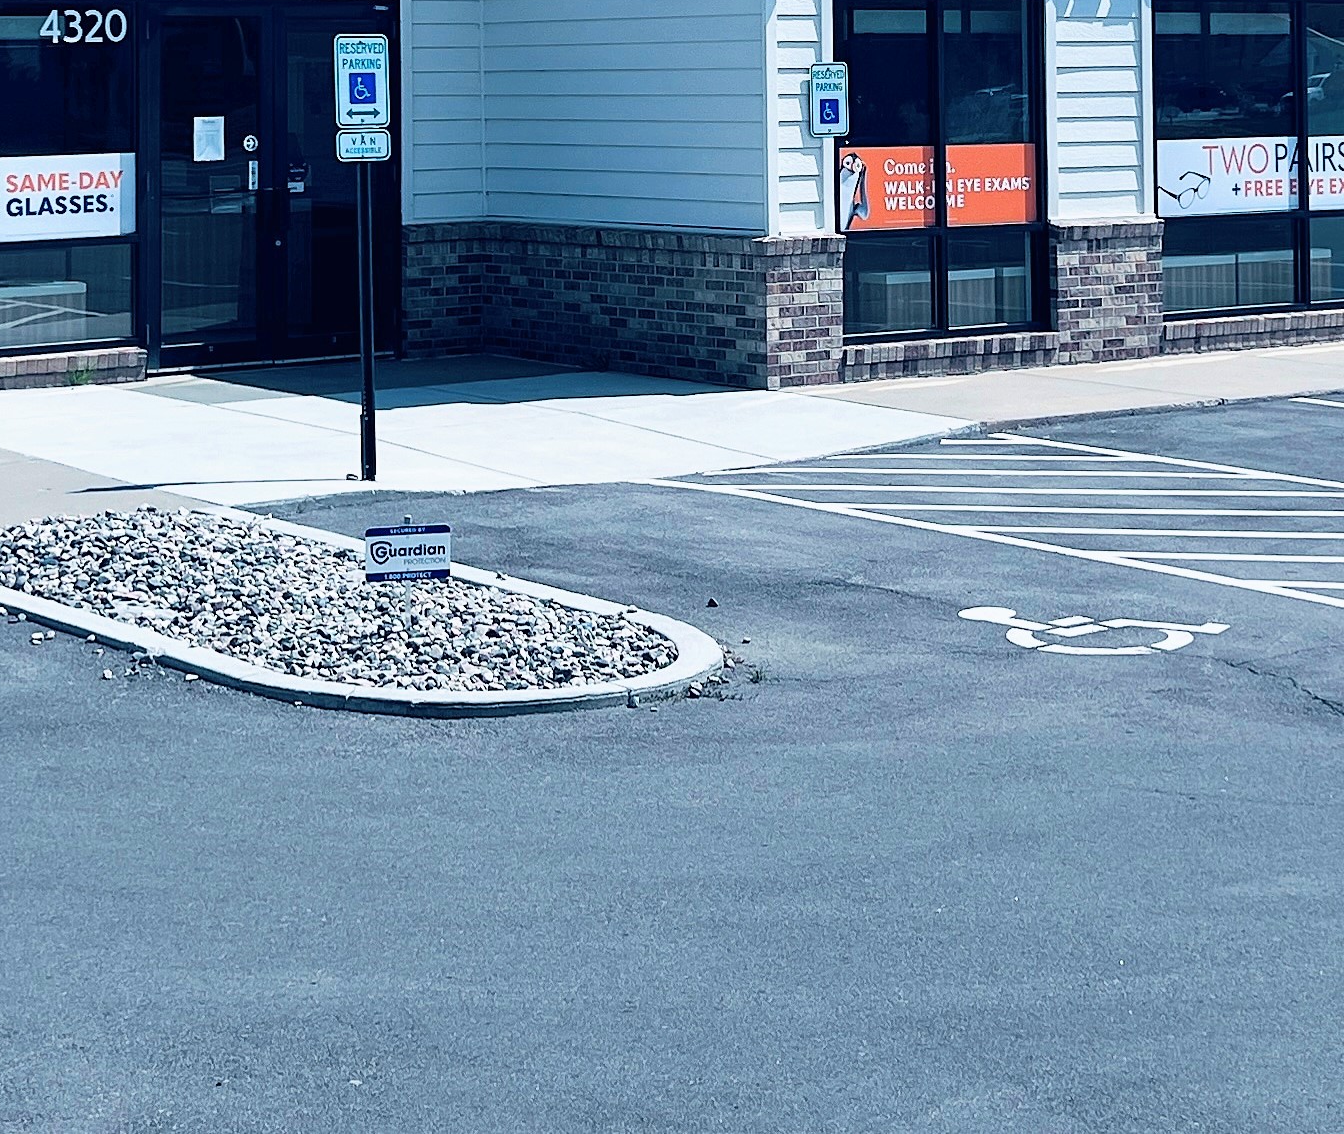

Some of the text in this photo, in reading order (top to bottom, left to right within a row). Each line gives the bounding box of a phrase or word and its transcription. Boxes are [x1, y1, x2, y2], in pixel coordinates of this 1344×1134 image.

[39, 8, 128, 44] 4320
[339, 42, 385, 55] RESERVED
[341, 58, 382, 70] PARKING
[812, 69, 845, 80] RESERVED
[815, 81, 843, 92] PARKING
[351, 136, 377, 146] VAN
[883, 158, 926, 176] Come
[1202, 143, 1269, 175] TWO
[6, 169, 123, 193] SAME-DAY
[884, 176, 1031, 196] WALK-IN EYE EXAMS
[1289, 178, 1324, 196] EYE
[6, 194, 115, 217] GLASSES.
[884, 194, 966, 211] WELCOME
[375, 543, 446, 558] Guardian
[403, 557, 446, 565] PROTECTION
